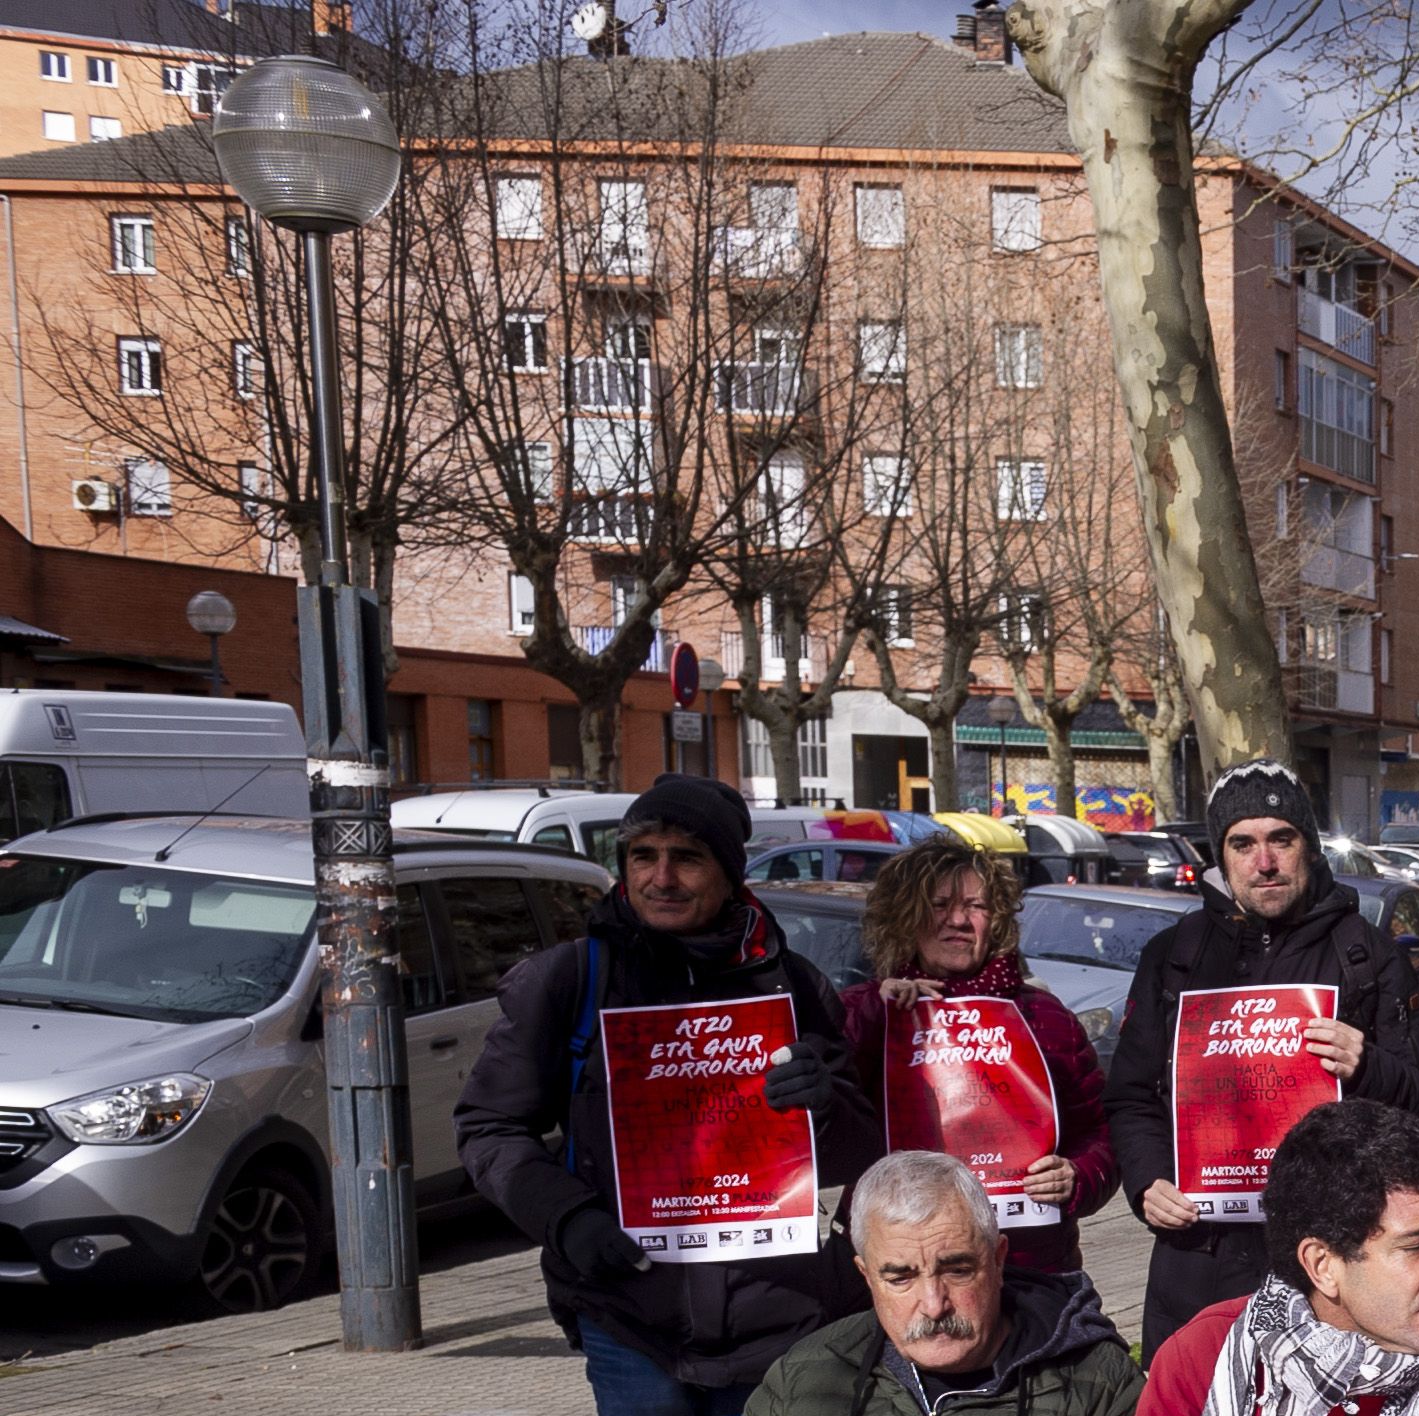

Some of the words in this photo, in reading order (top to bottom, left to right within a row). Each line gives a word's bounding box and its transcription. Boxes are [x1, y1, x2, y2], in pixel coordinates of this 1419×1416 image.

[1231, 998, 1276, 1017] ATZO
[676, 1015, 733, 1038] ATZO
[934, 1009, 980, 1026] ATZO
[1209, 1020, 1248, 1037] ETA
[1250, 1017, 1300, 1036] GAUR
[912, 1030, 954, 1046] ETA
[957, 1026, 1006, 1045] GAUR
[1203, 1034, 1303, 1057] BORROKAN
[650, 1042, 700, 1060] ETA
[703, 1034, 763, 1057] GAUR
[908, 1042, 1012, 1066] BORROKAN
[644, 1051, 767, 1080] BORROKAN
[971, 1152, 1003, 1165] 2024
[1253, 1148, 1276, 1159] 202
[978, 1171, 985, 1180] 3
[1202, 1165, 1258, 1176] MARTXOAK
[1261, 1165, 1268, 1176] 3
[713, 1173, 750, 1188] 2024
[652, 1193, 718, 1208] MARTXOAK
[721, 1194, 729, 1205] 3
